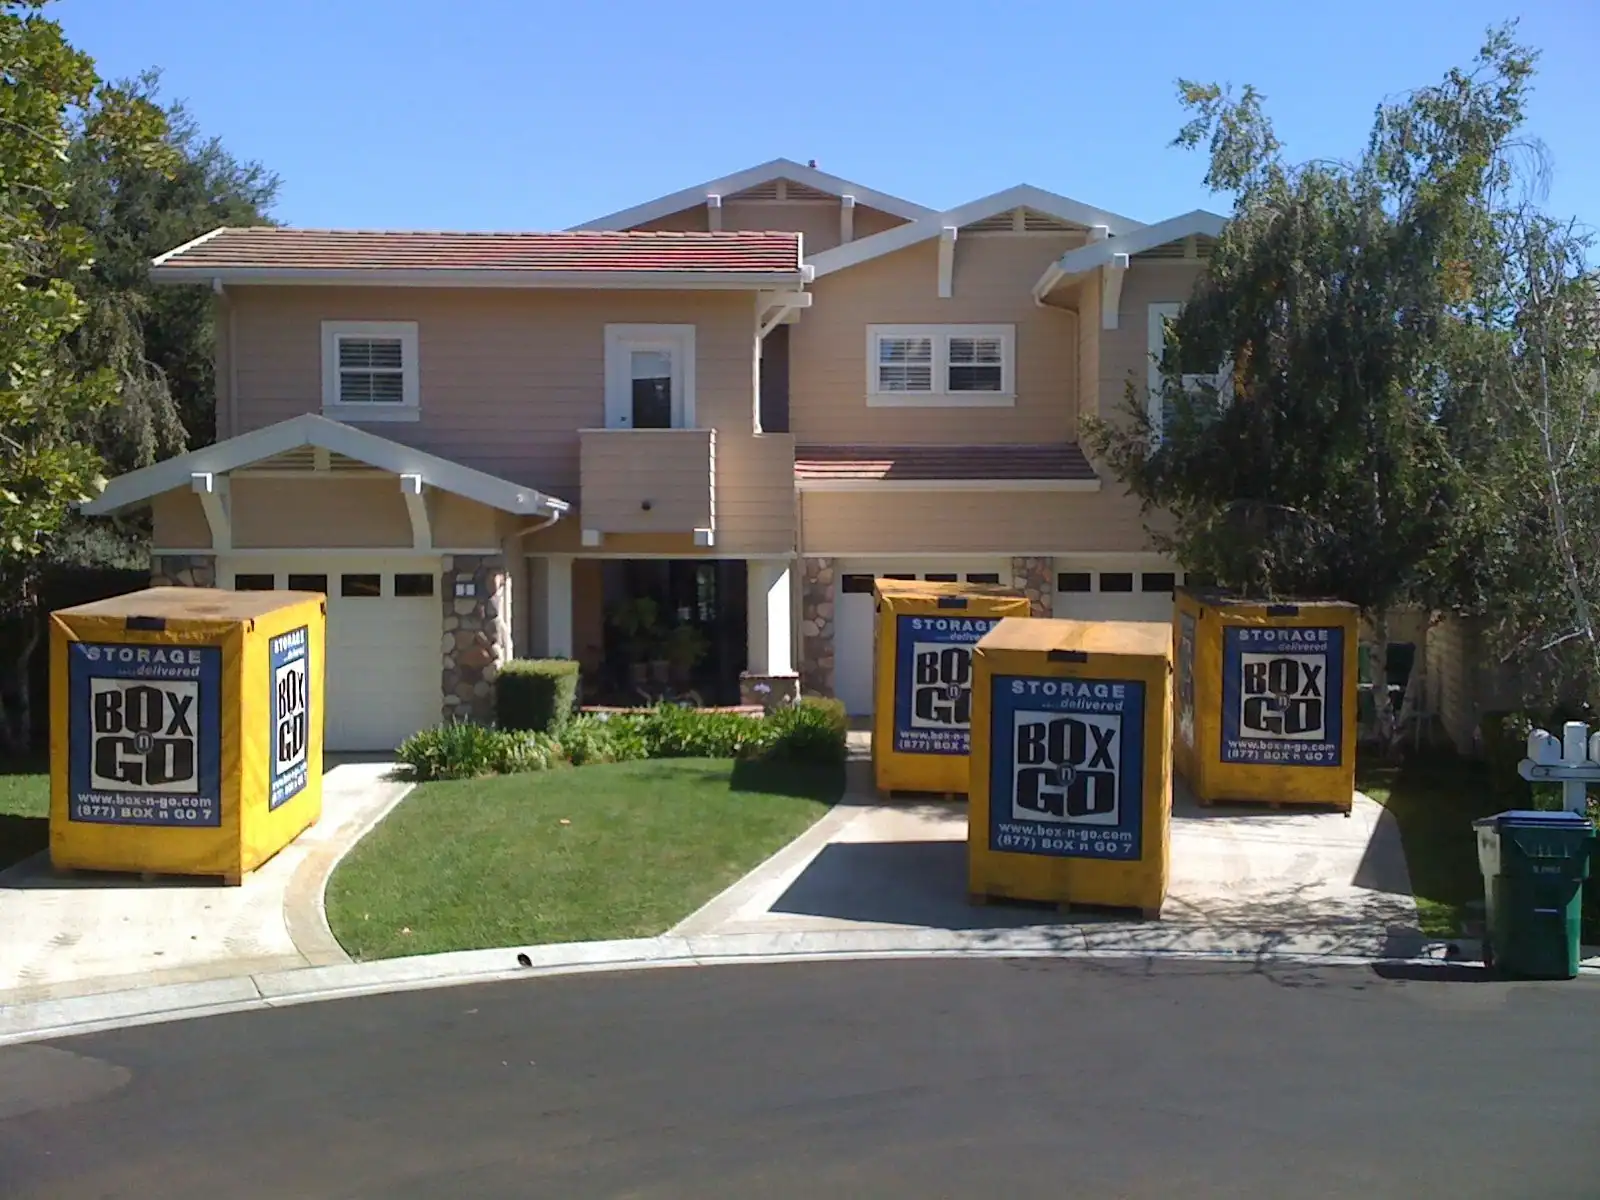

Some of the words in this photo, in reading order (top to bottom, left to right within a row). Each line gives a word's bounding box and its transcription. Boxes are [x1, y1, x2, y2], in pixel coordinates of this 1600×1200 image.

[1239, 629, 1329, 641] STORAGE
[87, 647, 202, 664] STORAGE
[917, 647, 972, 685] BO
[1244, 658, 1322, 697] BOX
[278, 669, 304, 720] BOX
[1011, 679, 1125, 699] STORAGE
[95, 685, 194, 737] BOX
[1244, 696, 1322, 735] GO
[278, 711, 304, 762] GO
[899, 740, 930, 751] (877)
[934, 740, 959, 750] BOX
[900, 731, 971, 742] www.box-n-g
[1017, 718, 1117, 770] BOX
[1228, 740, 1336, 752] www.box-n-go.com
[95, 735, 194, 786] GO
[1227, 749, 1259, 761] (877)
[1263, 751, 1290, 760] BOX
[1304, 752, 1324, 761] GO
[1327, 752, 1334, 760] 7
[77, 793, 212, 808] www.box-n-go.com
[1016, 767, 1116, 817] GO
[77, 805, 116, 819] (877)
[121, 808, 154, 819] BOX
[159, 810, 168, 819] n
[176, 809, 197, 820] GO
[203, 810, 212, 820] 7
[998, 823, 1132, 841] www.box-n-go.com
[996, 834, 1037, 851] (877)
[1042, 838, 1075, 850] BOX
[1079, 841, 1089, 851] n
[1094, 841, 1117, 853] GO
[1123, 843, 1132, 853] 7
